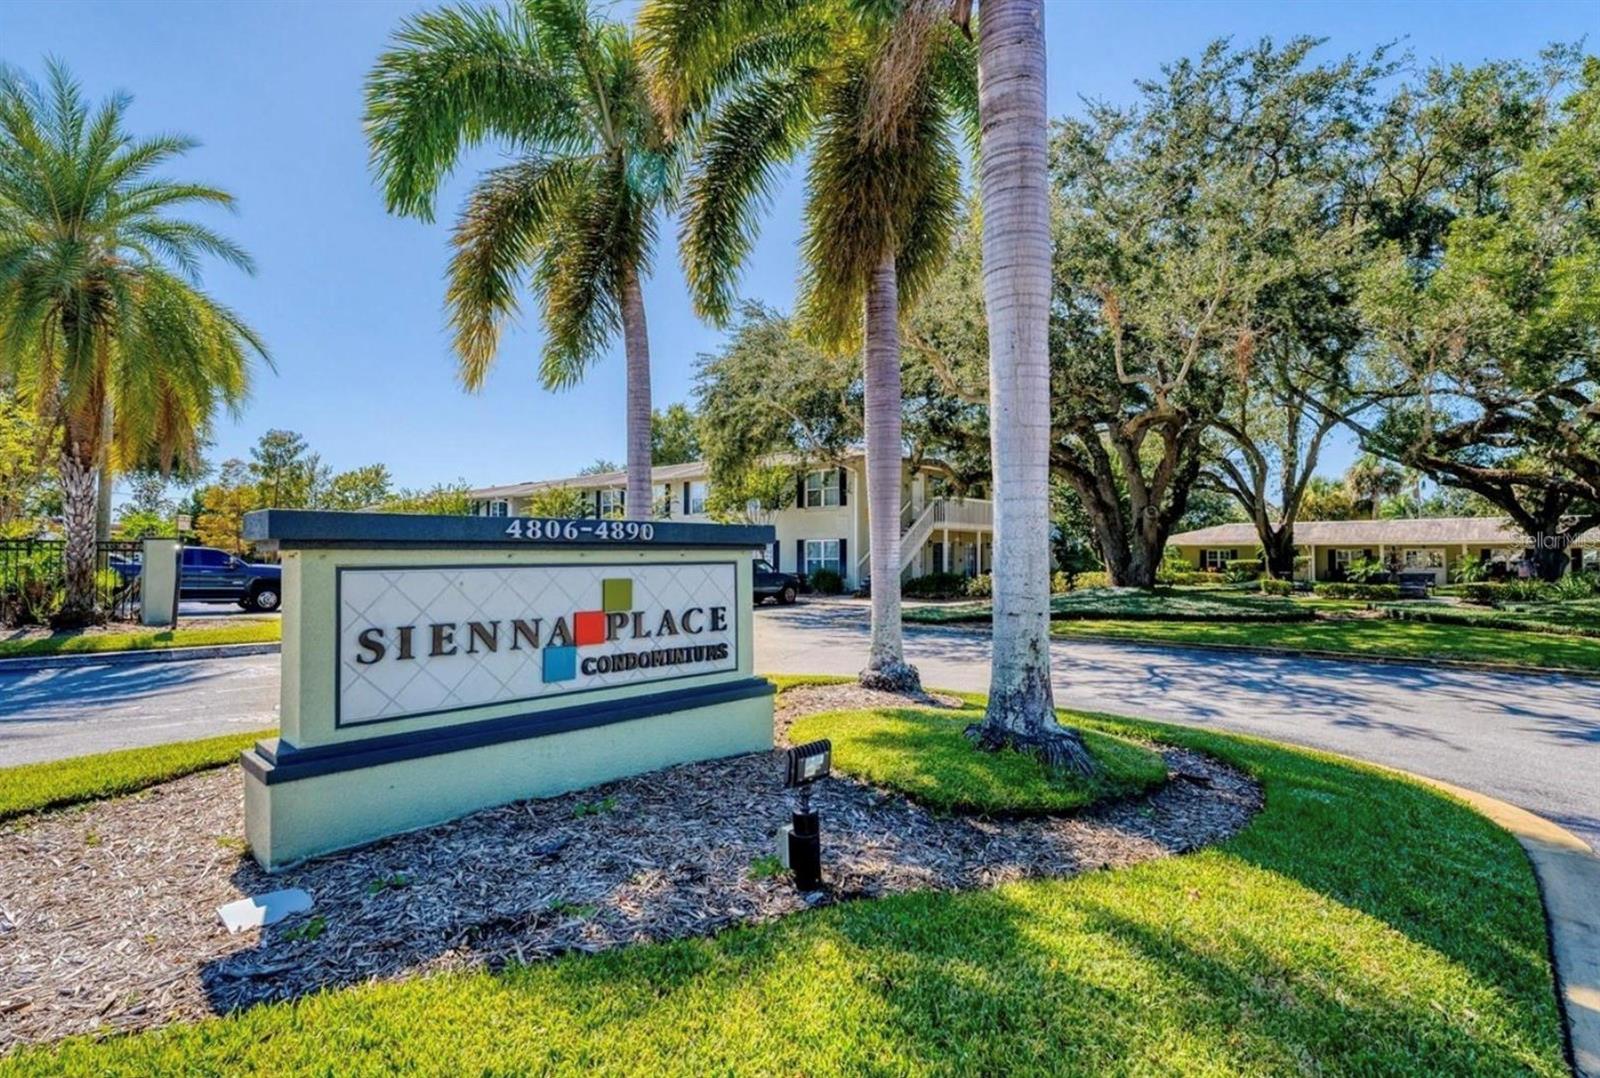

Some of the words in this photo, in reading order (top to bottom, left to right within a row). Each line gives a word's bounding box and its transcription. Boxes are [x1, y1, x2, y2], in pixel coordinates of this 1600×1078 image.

[505, 519, 655, 541] 4806-4890
[356, 617, 575, 665] SIENNA
[606, 606, 728, 641] PLACE
[581, 643, 729, 676] CONDOMINIUMS
